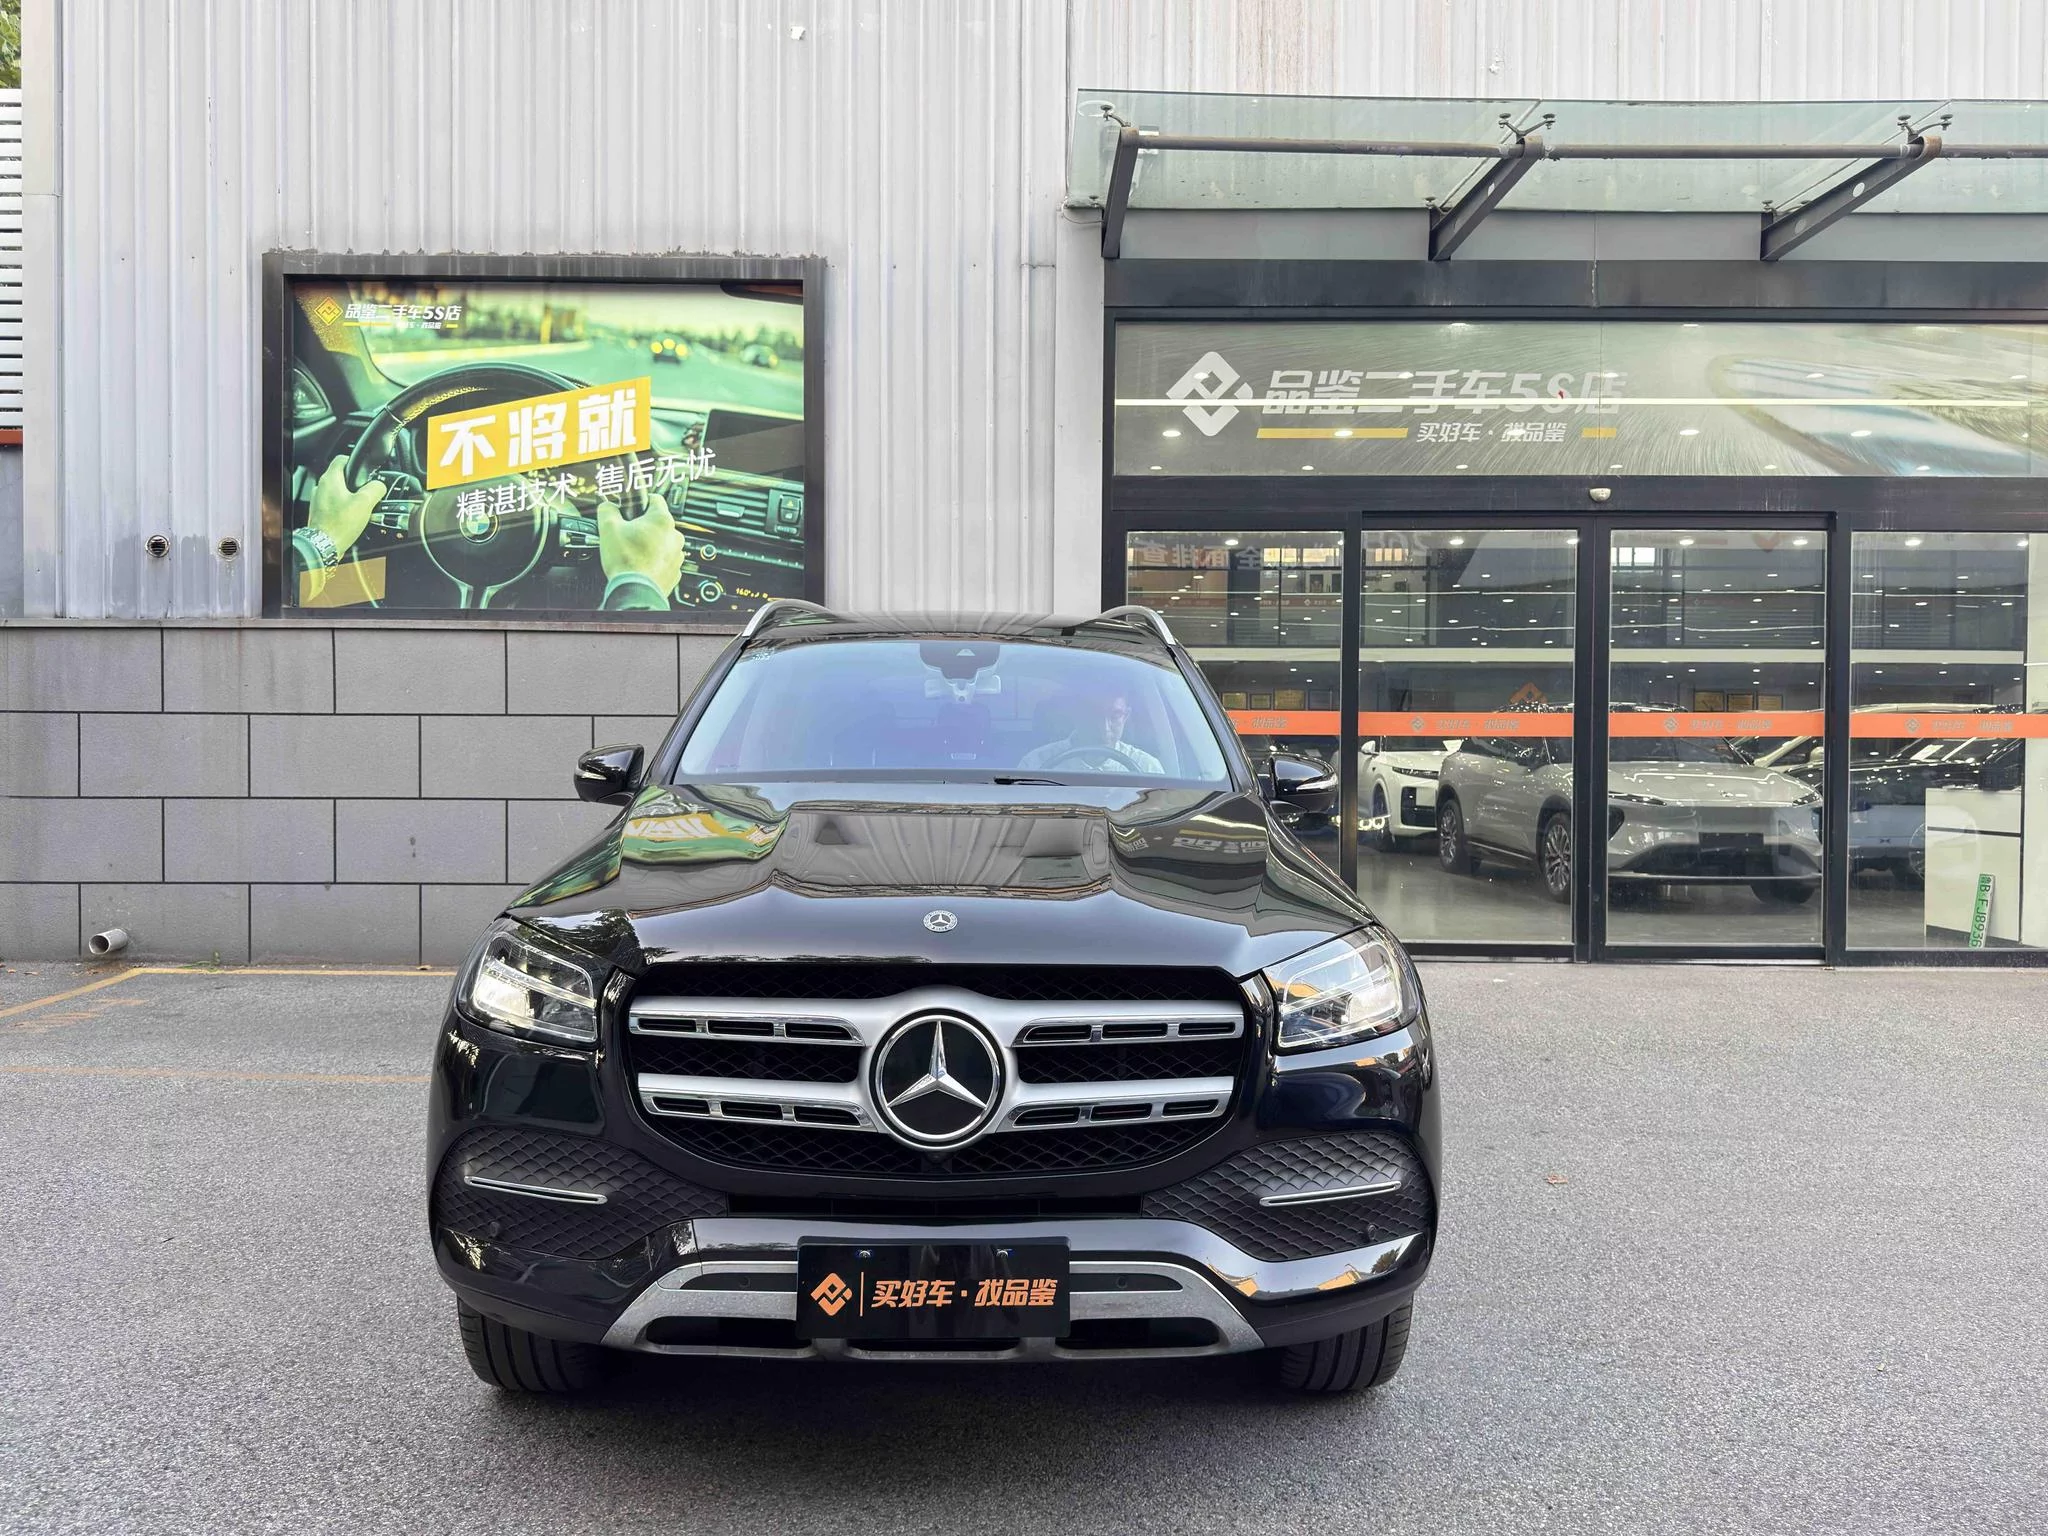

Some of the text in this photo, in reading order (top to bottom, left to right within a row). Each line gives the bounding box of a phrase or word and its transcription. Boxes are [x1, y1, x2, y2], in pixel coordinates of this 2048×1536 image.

[1262, 369, 1628, 415] 品鉴二手车5S店
[439, 387, 637, 477] 不将就
[456, 447, 717, 522] 精湛技术 售后无忧
[871, 1279, 1058, 1308] 买好车·找品鉴
